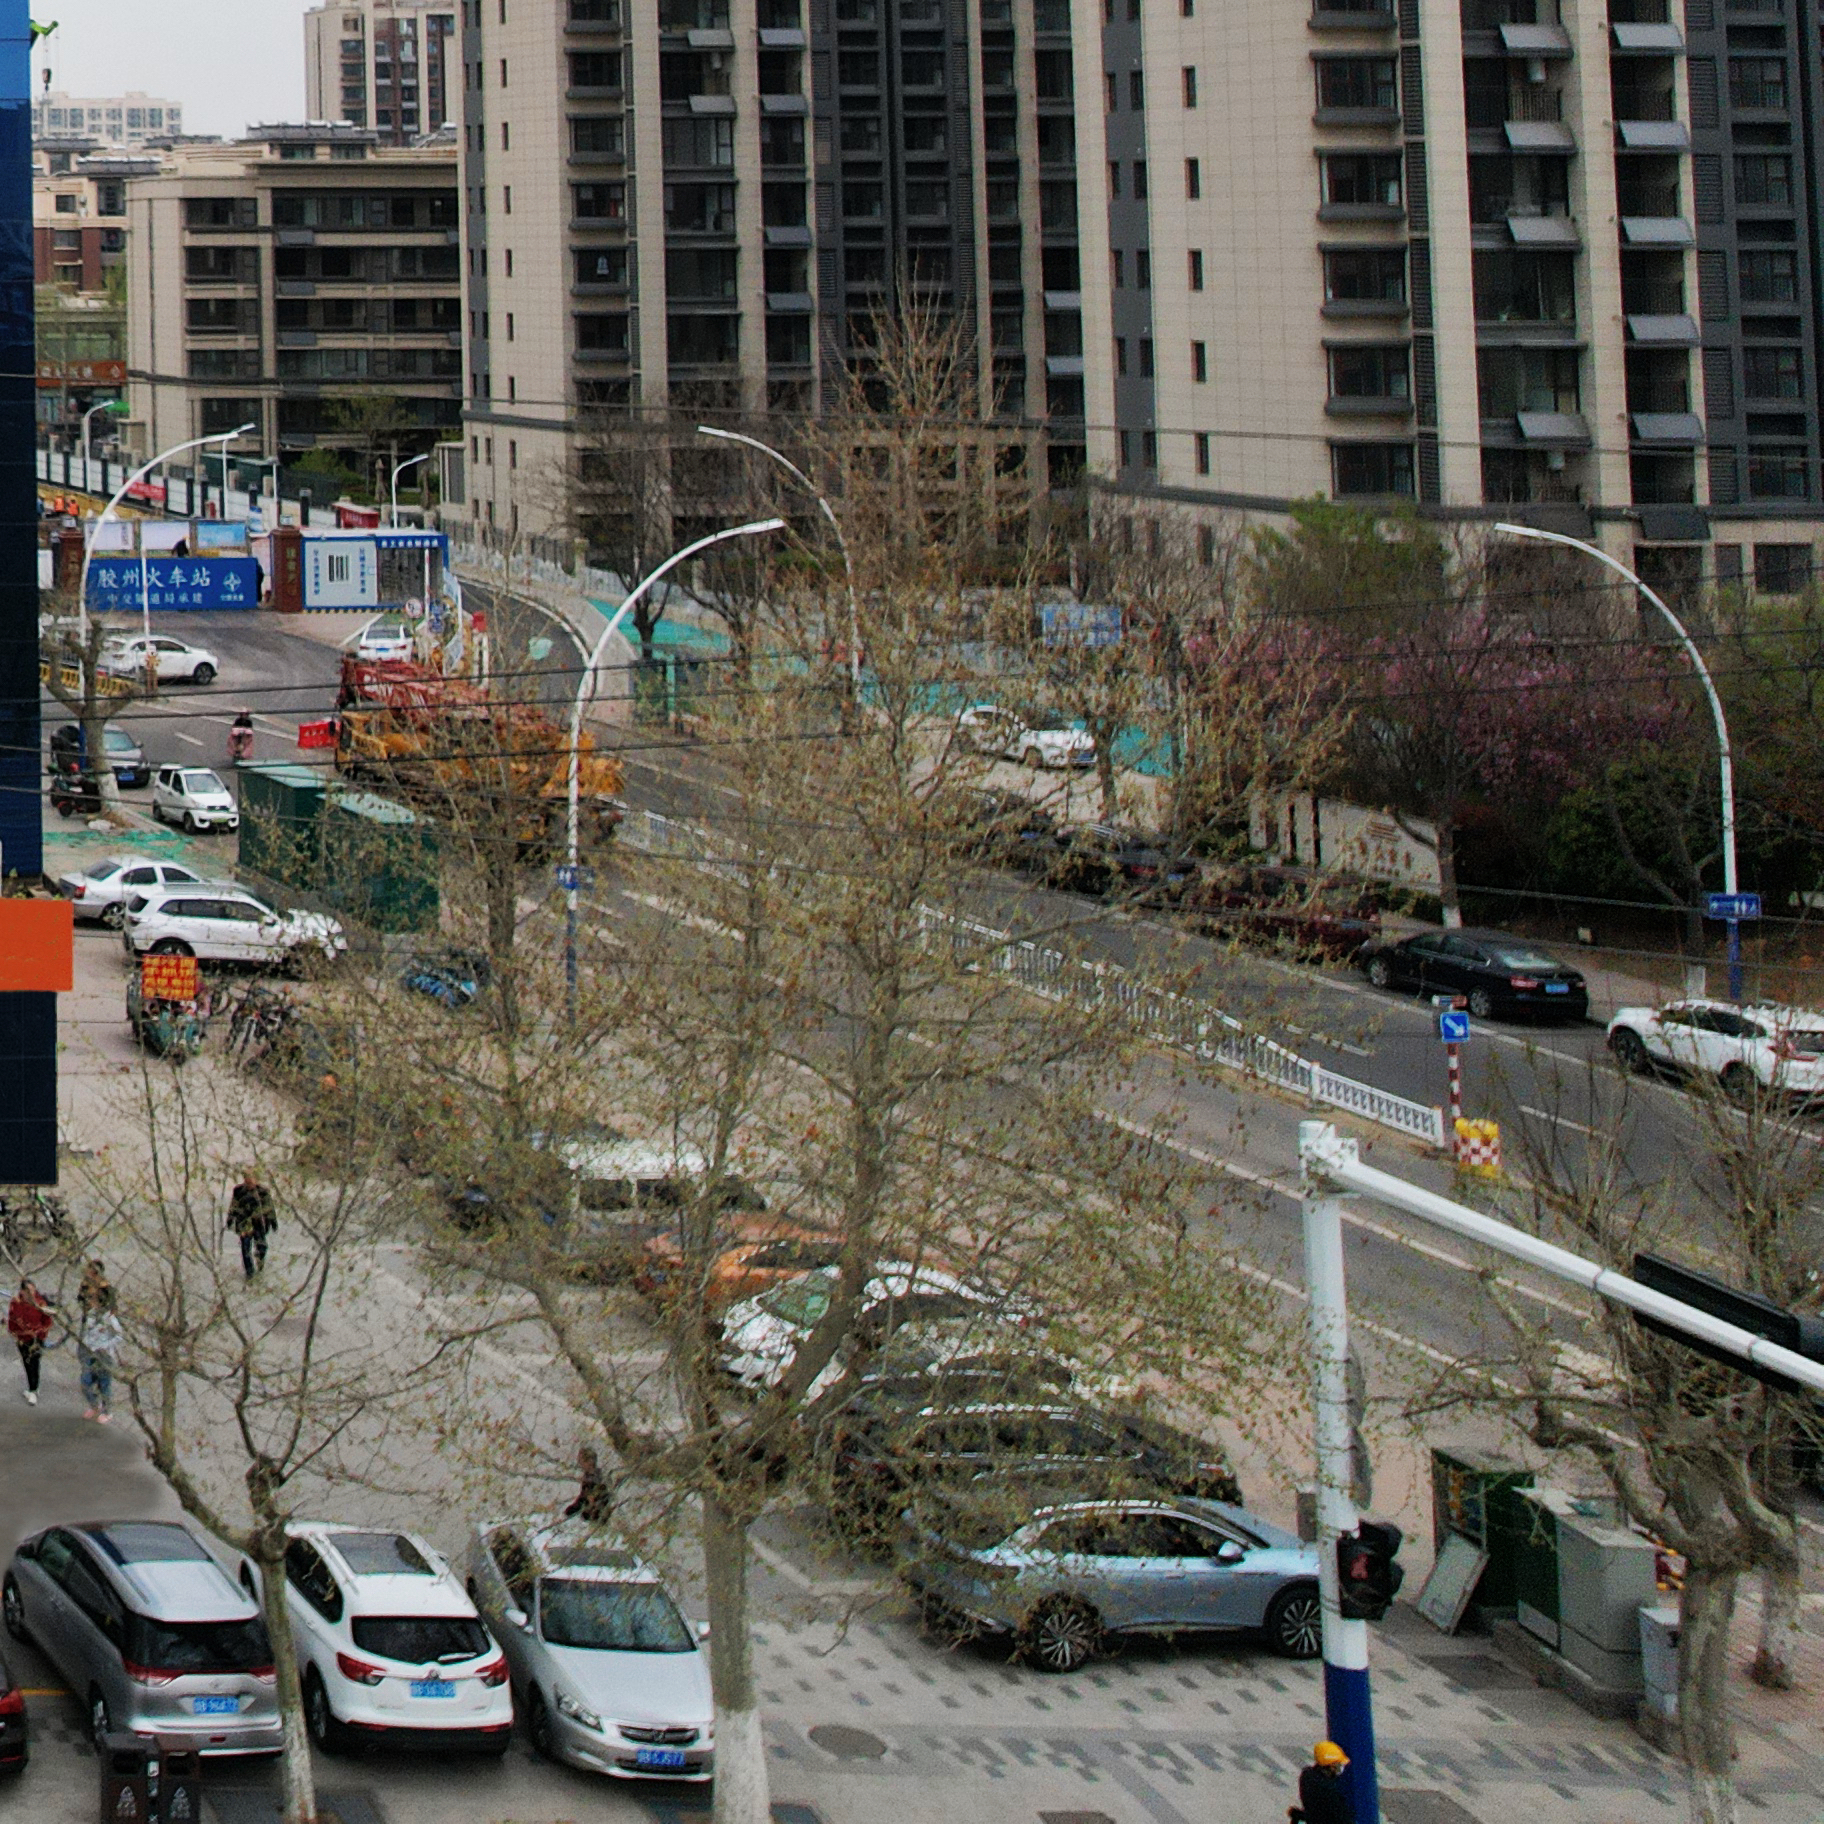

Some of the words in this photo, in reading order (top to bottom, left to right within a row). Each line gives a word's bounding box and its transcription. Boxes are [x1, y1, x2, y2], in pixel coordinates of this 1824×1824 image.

[97, 565, 211, 589] 胶州火车站
